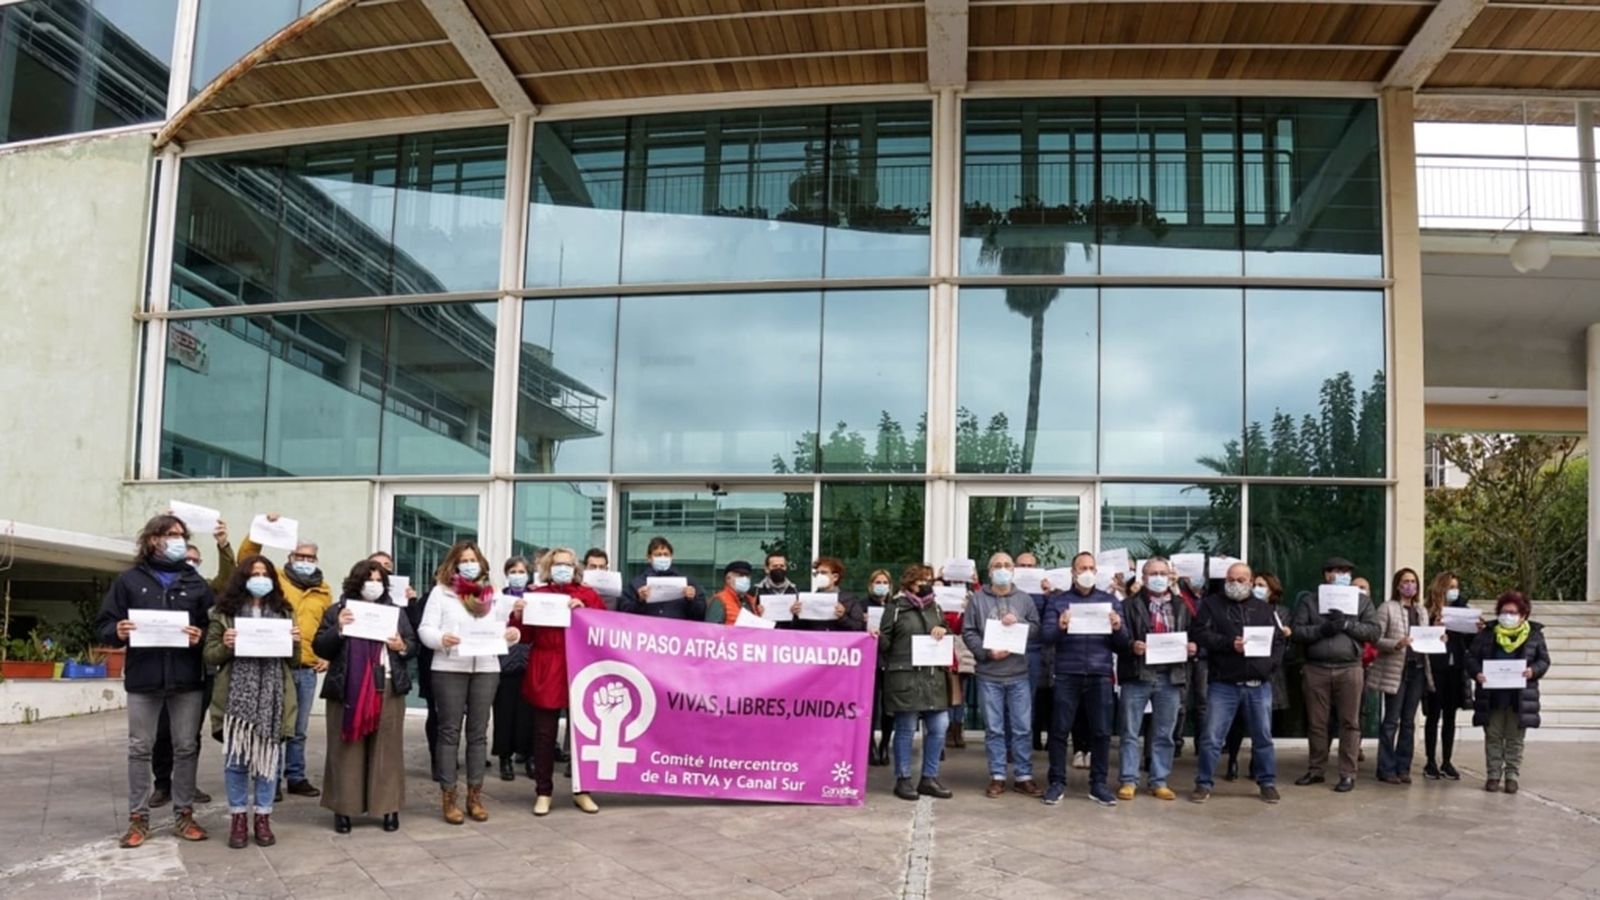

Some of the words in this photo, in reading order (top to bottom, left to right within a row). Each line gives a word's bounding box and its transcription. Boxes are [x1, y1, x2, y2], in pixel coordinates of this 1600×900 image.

[587, 626, 605, 647] NI
[608, 628, 632, 650] UN
[636, 631, 681, 656] PASO
[683, 636, 738, 661] ATRÁS
[742, 643, 767, 663] EN
[773, 645, 862, 667] IGUALDAD
[650, 751, 704, 767] Comité
[708, 756, 799, 773] Intercentros
[640, 770, 660, 783] de
[664, 771, 678, 784] la
[682, 772, 720, 787] RTVA
[723, 777, 733, 790] y
[736, 775, 777, 790] Canal
[781, 777, 806, 791] Sur
